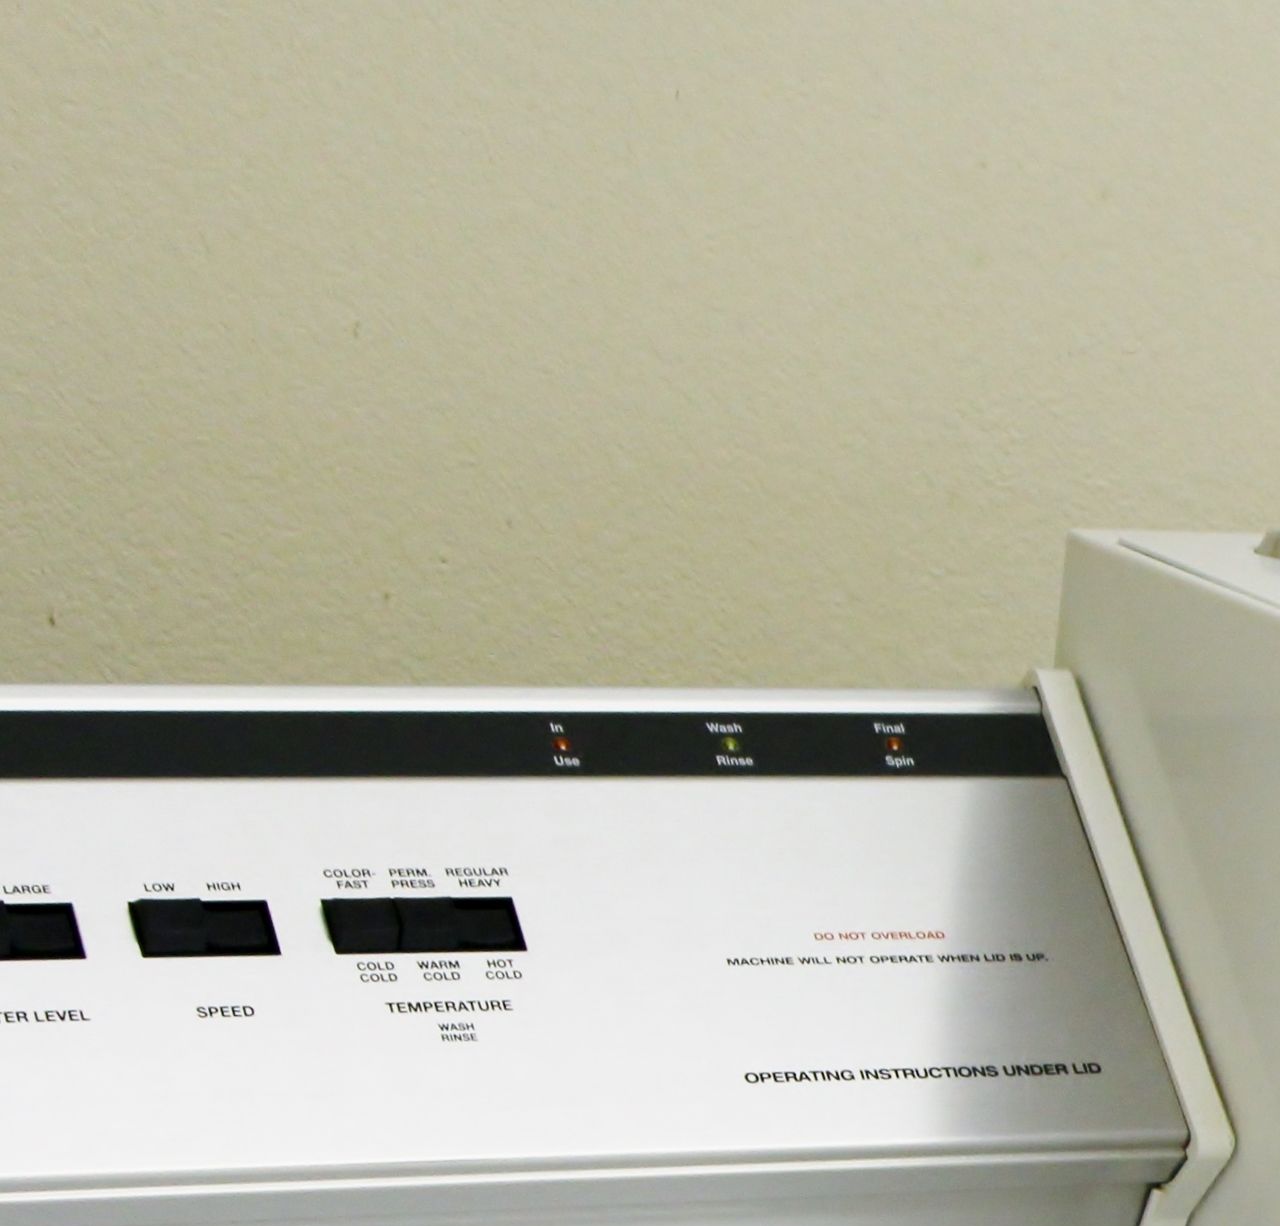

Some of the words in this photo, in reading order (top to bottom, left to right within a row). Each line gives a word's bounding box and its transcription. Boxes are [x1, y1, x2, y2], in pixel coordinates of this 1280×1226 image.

[549, 722, 564, 733] In
[705, 722, 743, 734] Wash
[873, 722, 906, 734] Final
[553, 755, 581, 767] Use
[715, 754, 754, 767] Rinse
[885, 754, 915, 769] Spin
[322, 868, 375, 879] COLOR-
[388, 868, 432, 878] PERM.
[444, 867, 509, 877] REGULAR
[143, 883, 175, 893] LOW
[206, 881, 242, 892] HIGH
[335, 879, 368, 889] FAST
[390, 879, 436, 889] PRESS
[458, 878, 501, 888] HEAVY
[2, 884, 51, 895] LARGE
[813, 932, 835, 941] DO
[837, 931, 866, 941] NOT
[870, 930, 947, 941] OVERLOAD
[486, 958, 513, 969] HOT
[726, 956, 794, 966] MACHINE
[797, 956, 832, 965] WILL
[835, 955, 864, 965] NOT
[869, 954, 935, 964] OPERATE
[937, 953, 982, 963] WHEN
[983, 953, 1007, 963] LID
[1008, 952, 1024, 963] IS
[1025, 952, 1049, 962] UP.
[356, 961, 395, 972] COLD
[416, 960, 461, 970] WARM
[359, 972, 399, 983] COLD
[422, 971, 461, 982] COLD
[485, 969, 523, 981] COLD
[196, 1005, 255, 1019] SPEED
[385, 999, 513, 1014] TEMPERATURE
[0, 1010, 29, 1024] ER
[33, 1009, 91, 1023] LEVEL
[437, 1022, 475, 1032] WASH
[440, 1032, 477, 1042] RINSE
[744, 1069, 856, 1084] OPERATING
[859, 1063, 1002, 1081] INSTRUCTIONS
[1002, 1062, 1070, 1077] UNDER
[1071, 1062, 1102, 1075] LID
